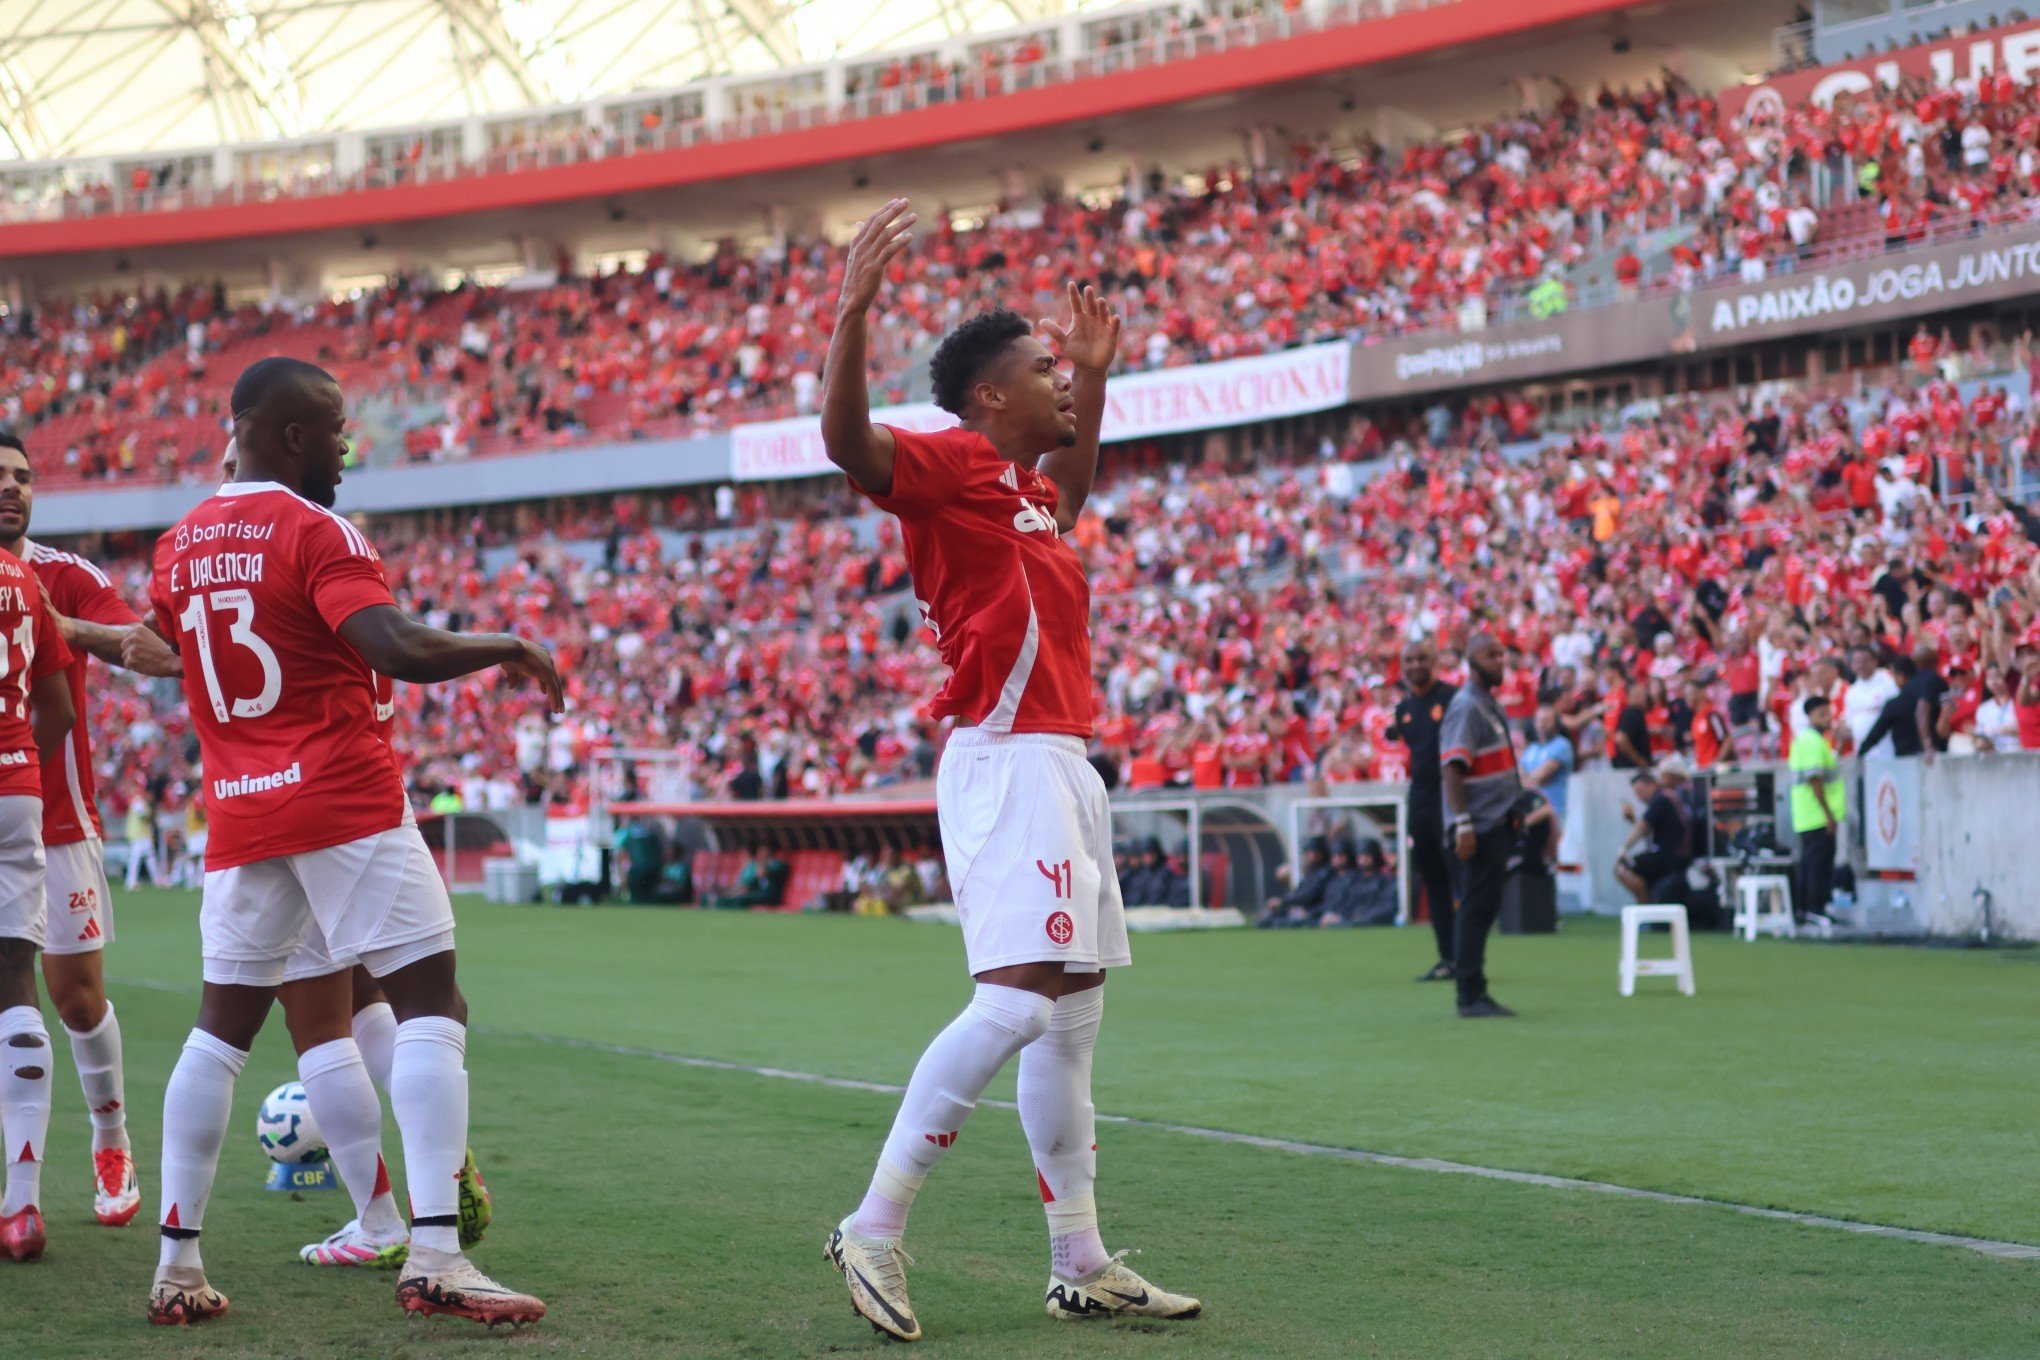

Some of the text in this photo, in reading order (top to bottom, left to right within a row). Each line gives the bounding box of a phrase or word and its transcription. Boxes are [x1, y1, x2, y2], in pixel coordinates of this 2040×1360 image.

[1711, 299, 1736, 332] A
[1738, 275, 1856, 327] PAIXÃO
[1858, 261, 1944, 306] JOGA
[1100, 356, 1343, 428] NTERNACIONAL
[193, 520, 274, 543] banrisul
[171, 552, 263, 593] E. VALENCIA
[15, 586, 30, 611] R.
[180, 588, 282, 723] 13
[214, 762, 301, 799] Unimed
[1036, 859, 1071, 898] 41
[293, 1170, 325, 1186] CBF
